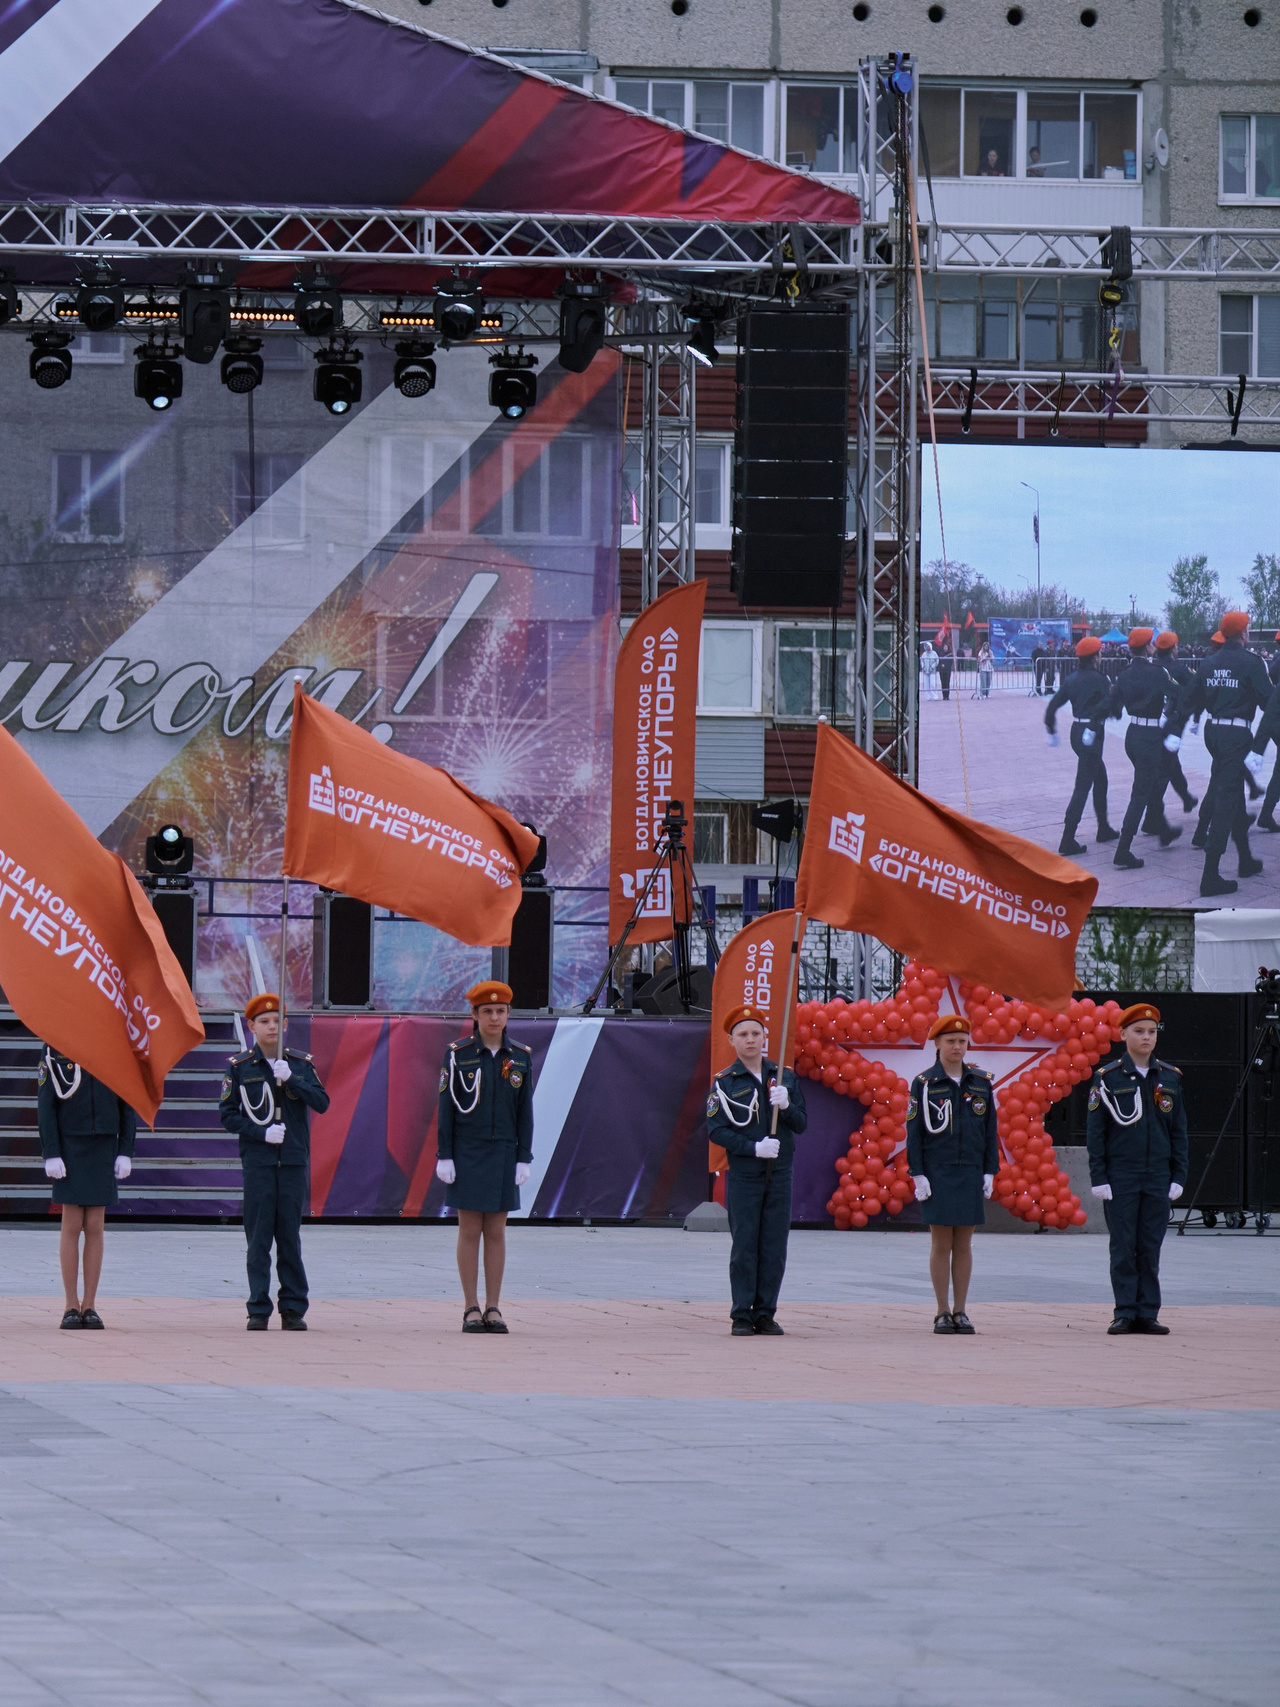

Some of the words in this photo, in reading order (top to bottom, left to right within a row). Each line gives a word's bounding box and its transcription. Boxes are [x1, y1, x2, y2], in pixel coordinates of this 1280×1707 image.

[640, 635, 656, 675] ОАО
[1213, 669, 1232, 678] МЧС
[1206, 677, 1239, 688] РОССИИ
[635, 683, 652, 851] БОГДАНОВИЧСКОЕ
[338, 785, 483, 851] БОГДАНОВИЧСКОЕ
[878, 838, 1023, 906] БОГДАНОВИЧСКОЕ
[1031, 899, 1067, 917] ОАО
[745, 944, 758, 972] ОАО
